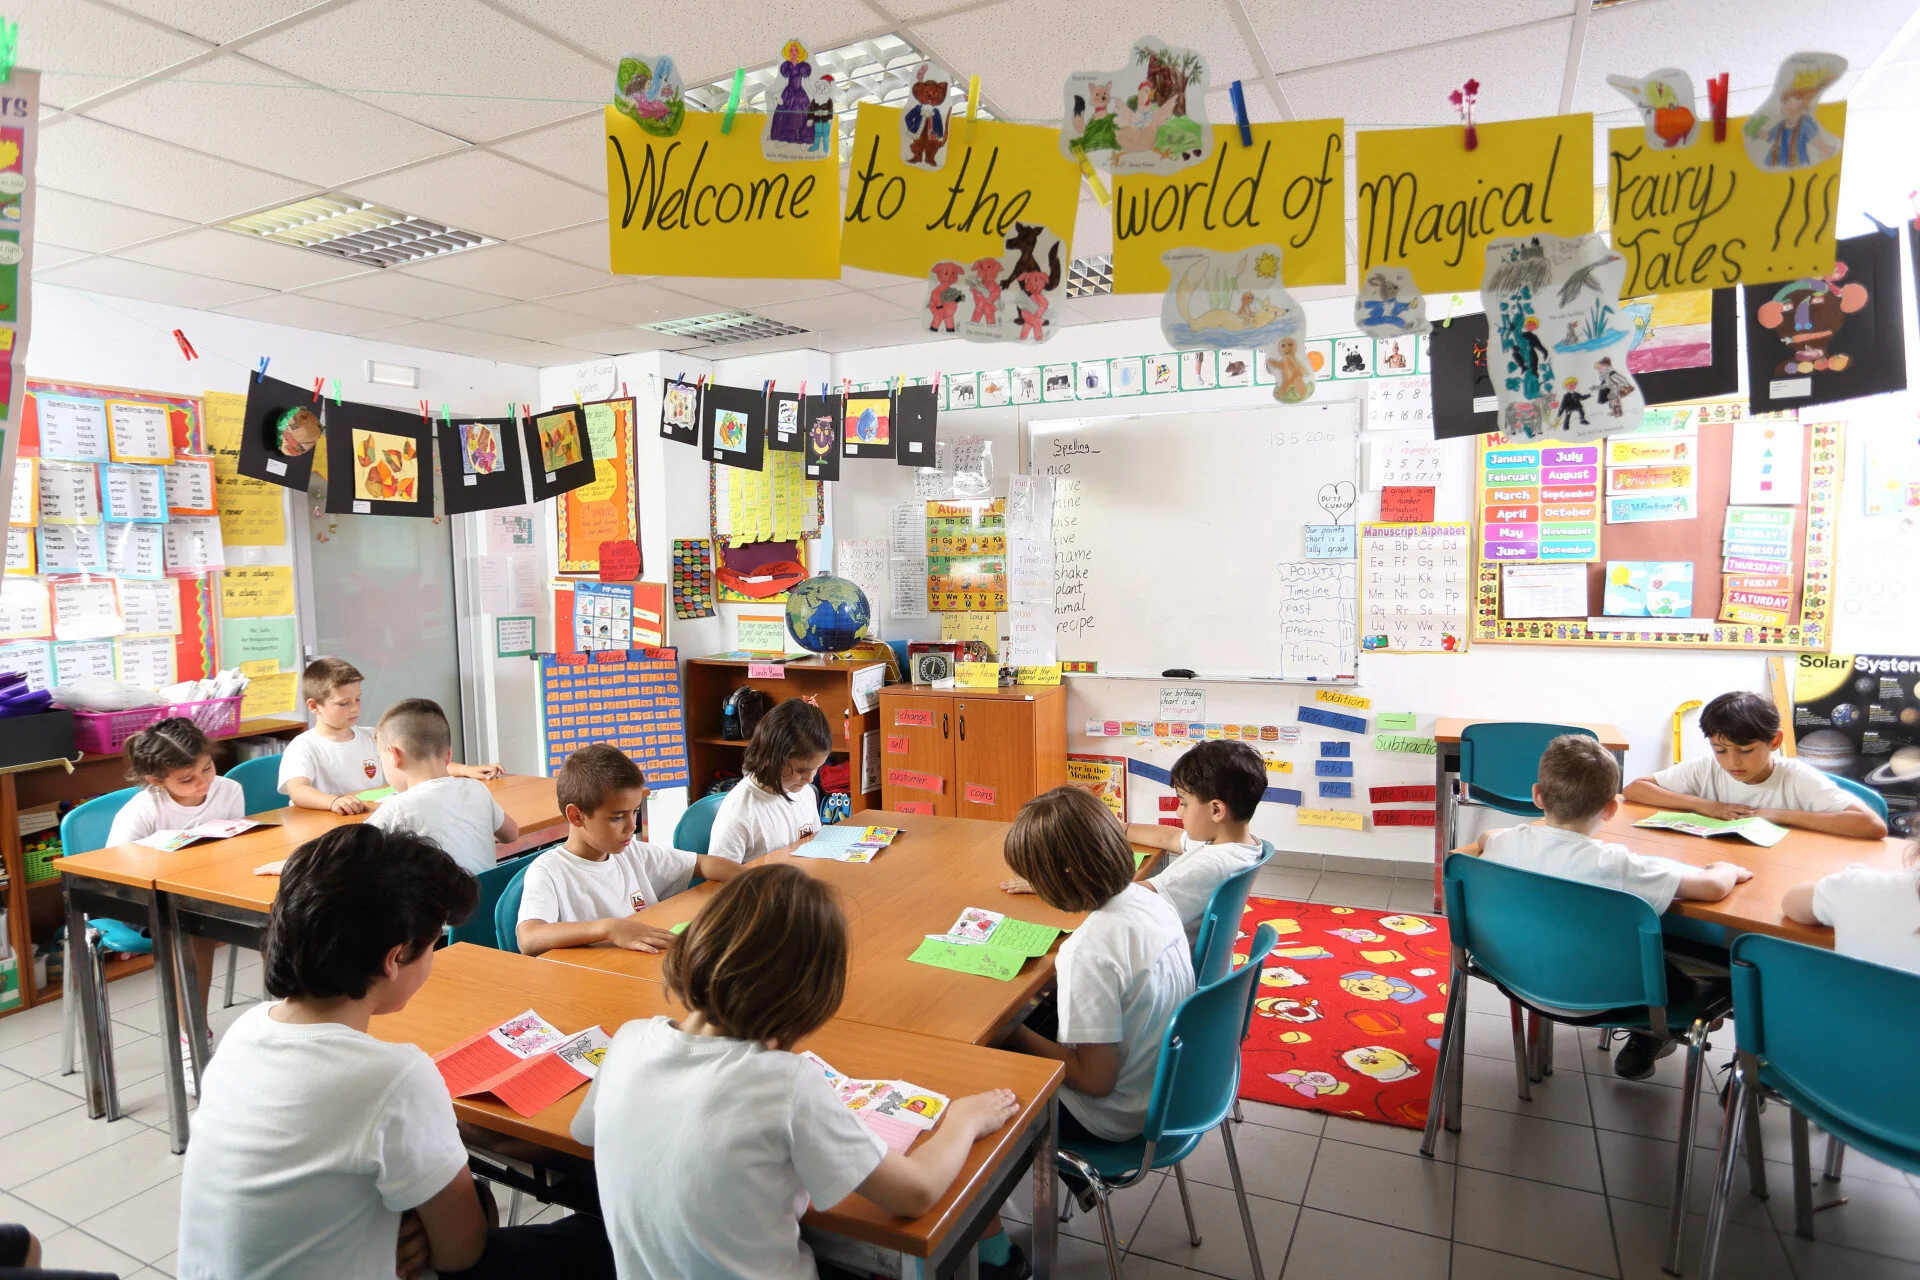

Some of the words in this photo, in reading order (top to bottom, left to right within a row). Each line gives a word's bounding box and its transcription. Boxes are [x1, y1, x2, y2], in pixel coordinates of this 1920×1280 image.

[608, 134, 816, 232] Welcome
[844, 133, 907, 223] to
[925, 146, 1032, 238] the
[1116, 139, 1271, 240] world
[1282, 132, 1342, 249] of
[1358, 133, 1563, 271] Magical
[1610, 145, 1736, 246] Fairy
[1617, 229, 1747, 296] Tales
[1382, 390, 1390, 399] 4
[1396, 389, 1404, 399] 6
[1413, 388, 1421, 399] 8
[47, 400, 76, 410] Spelling
[78, 401, 101, 411] Words
[1384, 410, 1394, 420] 14
[1401, 410, 1409, 420] 16
[1414, 409, 1423, 420] 18
[1053, 438, 1090, 456] Spelling
[1631, 447, 1671, 456] Summer
[1490, 454, 1535, 465] January
[1555, 452, 1583, 463] July
[1046, 463, 1071, 475] nice
[1385, 459, 1391, 468] 3
[1400, 459, 1408, 468] 5
[1416, 459, 1424, 468] 7
[1432, 459, 1440, 468] 9
[1401, 472, 1411, 480] 15
[1415, 472, 1427, 480] 17
[1430, 472, 1442, 480] 19
[1488, 473, 1537, 482] February
[1548, 470, 1590, 480] August
[1631, 472, 1672, 485] Autumn
[1391, 488, 1411, 497] graph
[1494, 491, 1530, 501] March
[1542, 490, 1595, 501] September
[1544, 508, 1592, 517] October
[1630, 502, 1673, 512] Winter
[1496, 509, 1527, 522] April
[1306, 526, 1317, 534] Our
[1321, 525, 1345, 537] points
[1363, 526, 1417, 539] Manuscript
[1420, 526, 1466, 539] Alphabet
[1499, 528, 1524, 539] May
[1542, 527, 1592, 536] November
[1733, 529, 1778, 538] TUESDAY
[1306, 534, 1324, 543] chart
[1328, 545, 1349, 555] graph
[1371, 541, 1384, 551] Aa
[1395, 541, 1409, 551] Bb
[1418, 540, 1433, 550] Cc
[1442, 540, 1457, 550] Dd
[1496, 546, 1526, 556] June
[1542, 546, 1592, 554] December
[1018, 555, 1050, 564] Timeline
[1054, 549, 1092, 564] name
[1371, 557, 1384, 567] Ee
[1394, 557, 1408, 567] Ff
[1418, 556, 1433, 570] Gg
[1443, 556, 1458, 566] Hh
[1729, 560, 1780, 573] THURSDAY
[252, 569, 275, 580] always
[1054, 564, 1089, 580] shake
[1290, 566, 1334, 577] POINTS
[1743, 578, 1779, 588] FRIDAY
[239, 589, 263, 600] always
[612, 587, 631, 595] attitudes
[1284, 581, 1330, 597] Timeline
[1732, 592, 1788, 607] SATURDAY
[1014, 610, 1033, 618] NOW
[1285, 602, 1312, 615] past
[945, 613, 957, 623] long
[969, 612, 983, 624] long
[1736, 609, 1779, 623] SUNDAY
[1014, 624, 1037, 632] THEN
[1056, 615, 1095, 639] recipe
[1285, 624, 1326, 640] present
[557, 654, 585, 664] before
[645, 649, 669, 659] after
[1290, 644, 1330, 666] future
[1799, 654, 1849, 669] Solar
[751, 668, 768, 677] Lunch
[1018, 667, 1036, 675] about
[1040, 667, 1050, 675] the
[1174, 689, 1203, 699] birthday
[1320, 691, 1365, 708] Addition
[899, 712, 927, 724] change
[1299, 709, 1323, 724] more
[1331, 713, 1357, 729] than
[891, 739, 904, 750] sell
[1321, 743, 1343, 755] and
[1376, 734, 1437, 755] Subtractio
[1084, 765, 1092, 773] in
[1094, 766, 1106, 774] the
[1320, 762, 1342, 773] add
[889, 771, 928, 785] customer
[1070, 770, 1101, 780] Meadow
[969, 788, 993, 801] coins
[1321, 783, 1344, 795] plus
[1371, 787, 1393, 800] take
[1401, 787, 1430, 801] away
[1376, 811, 1400, 824] take
[1409, 812, 1435, 824] from
